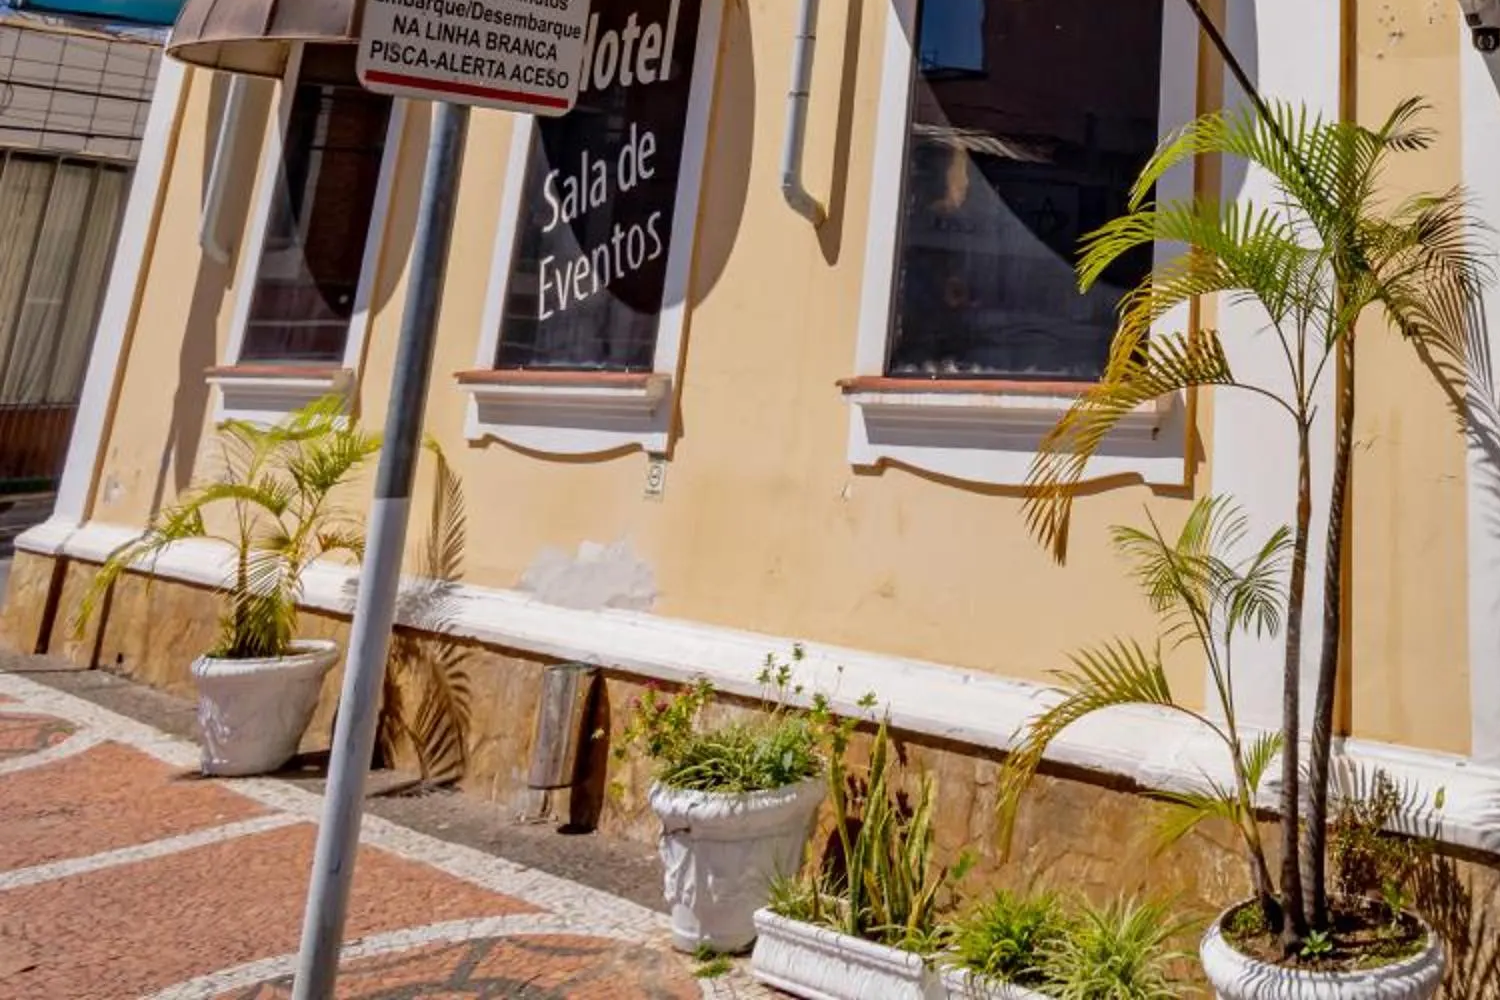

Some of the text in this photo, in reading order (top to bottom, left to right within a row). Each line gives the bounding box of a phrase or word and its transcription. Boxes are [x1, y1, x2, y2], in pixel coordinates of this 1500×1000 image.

[370, 40, 569, 89] PISCA-ALERTA ACESO
[392, 15, 557, 61] NA LINHA BRANCA
[542, 121, 656, 233] Sala de
[538, 211, 663, 321] Eventos
